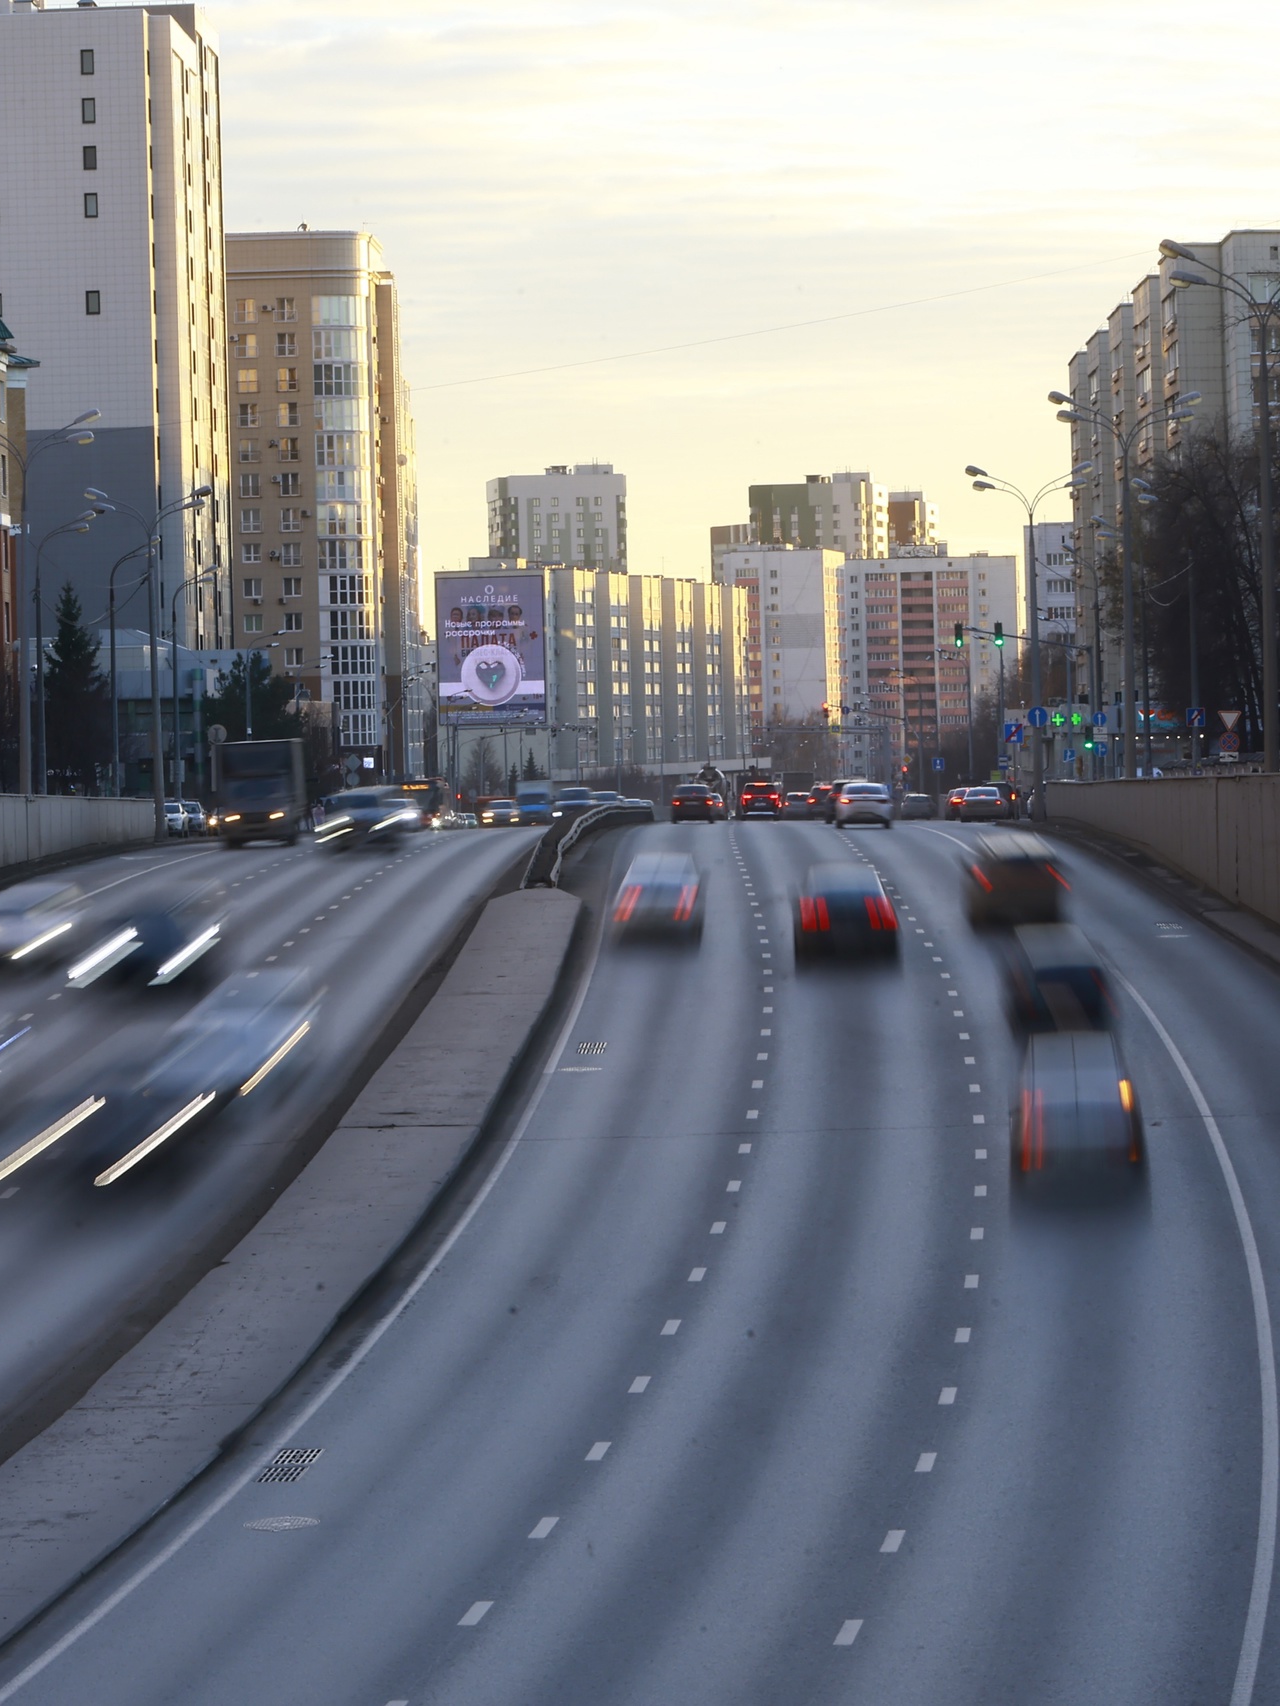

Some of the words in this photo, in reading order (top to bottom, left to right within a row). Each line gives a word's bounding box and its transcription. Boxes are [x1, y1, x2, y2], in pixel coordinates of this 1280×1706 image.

[461, 594, 518, 603] НАСЛЕДИЕ
[445, 620, 473, 628] Новые
[475, 620, 525, 628] программы
[445, 630, 495, 638] рассрочки
